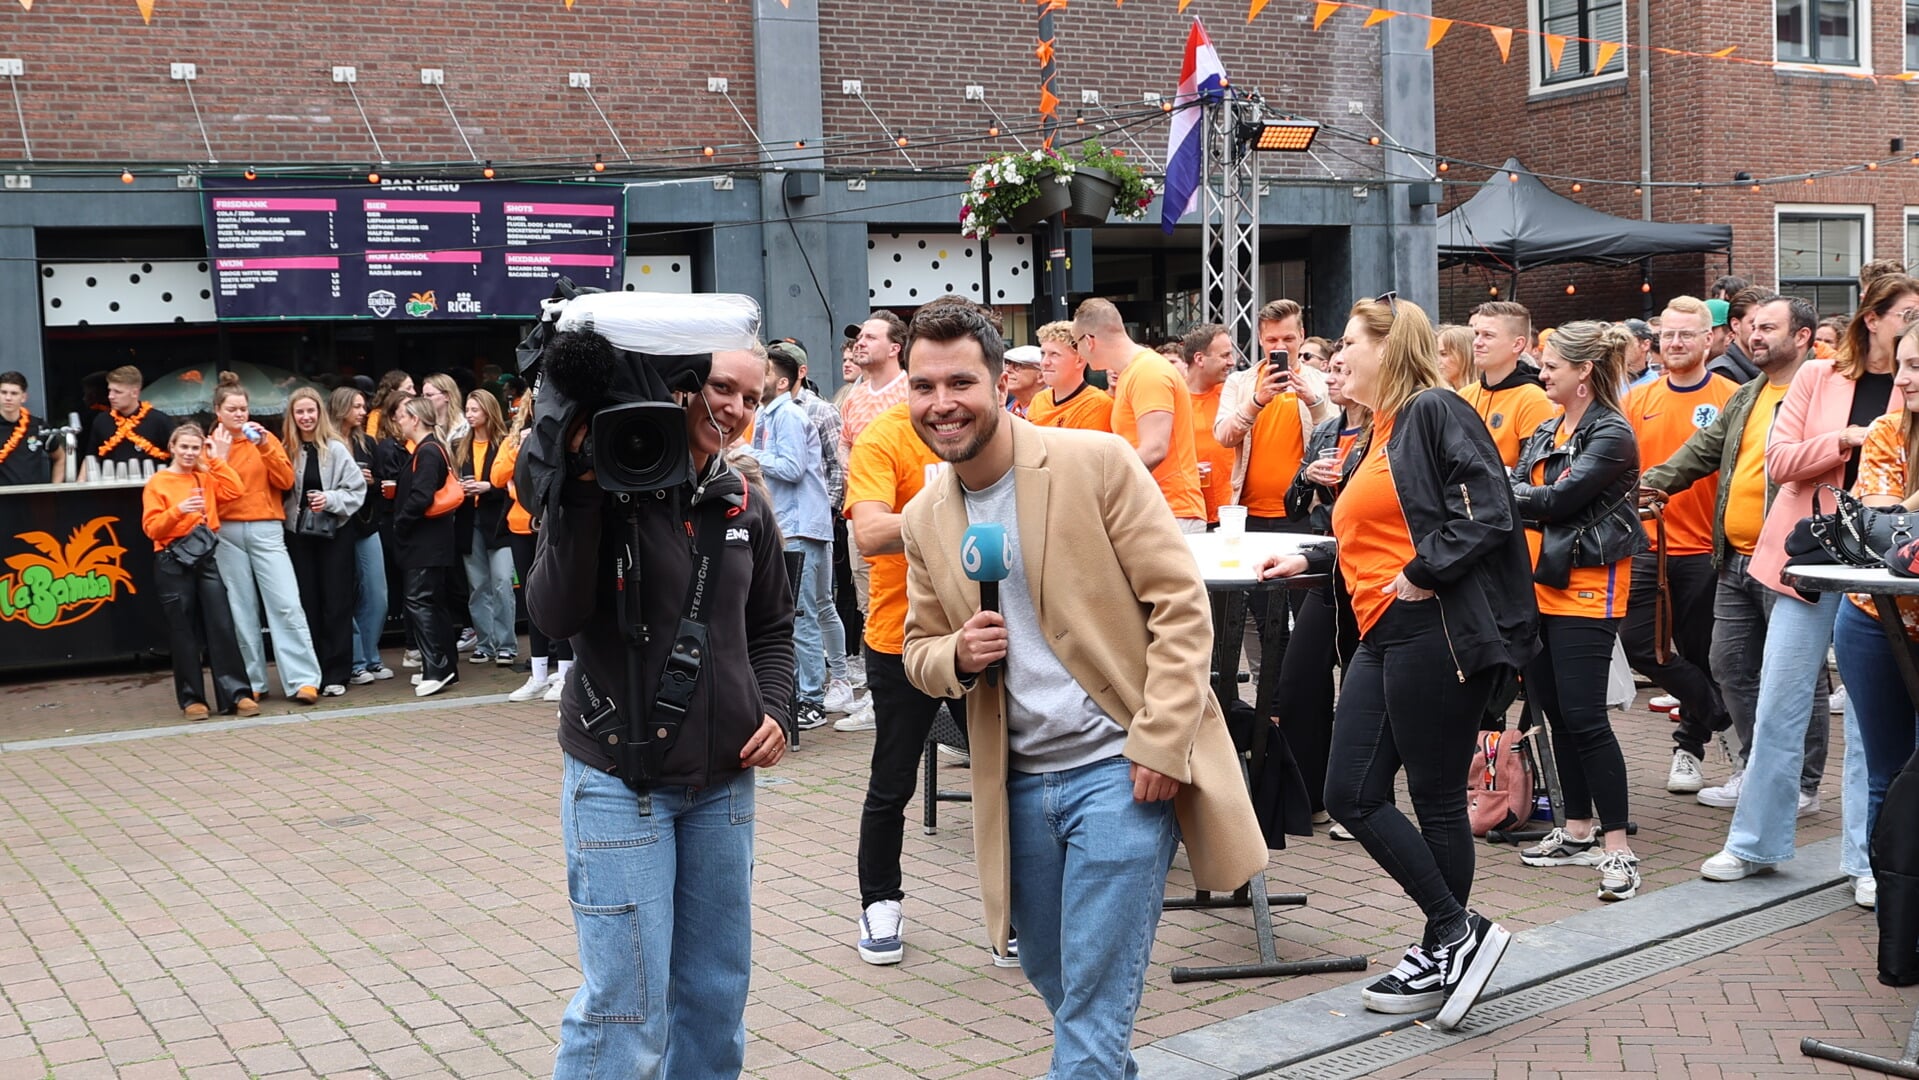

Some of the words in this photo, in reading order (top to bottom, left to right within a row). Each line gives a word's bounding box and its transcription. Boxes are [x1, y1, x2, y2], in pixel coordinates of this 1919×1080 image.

[381, 179, 413, 191] BAR
[216, 200, 268, 208] FRISDRANK
[448, 301, 481, 313] RICHE
[726, 528, 749, 542] EMG
[962, 535, 981, 572] 6
